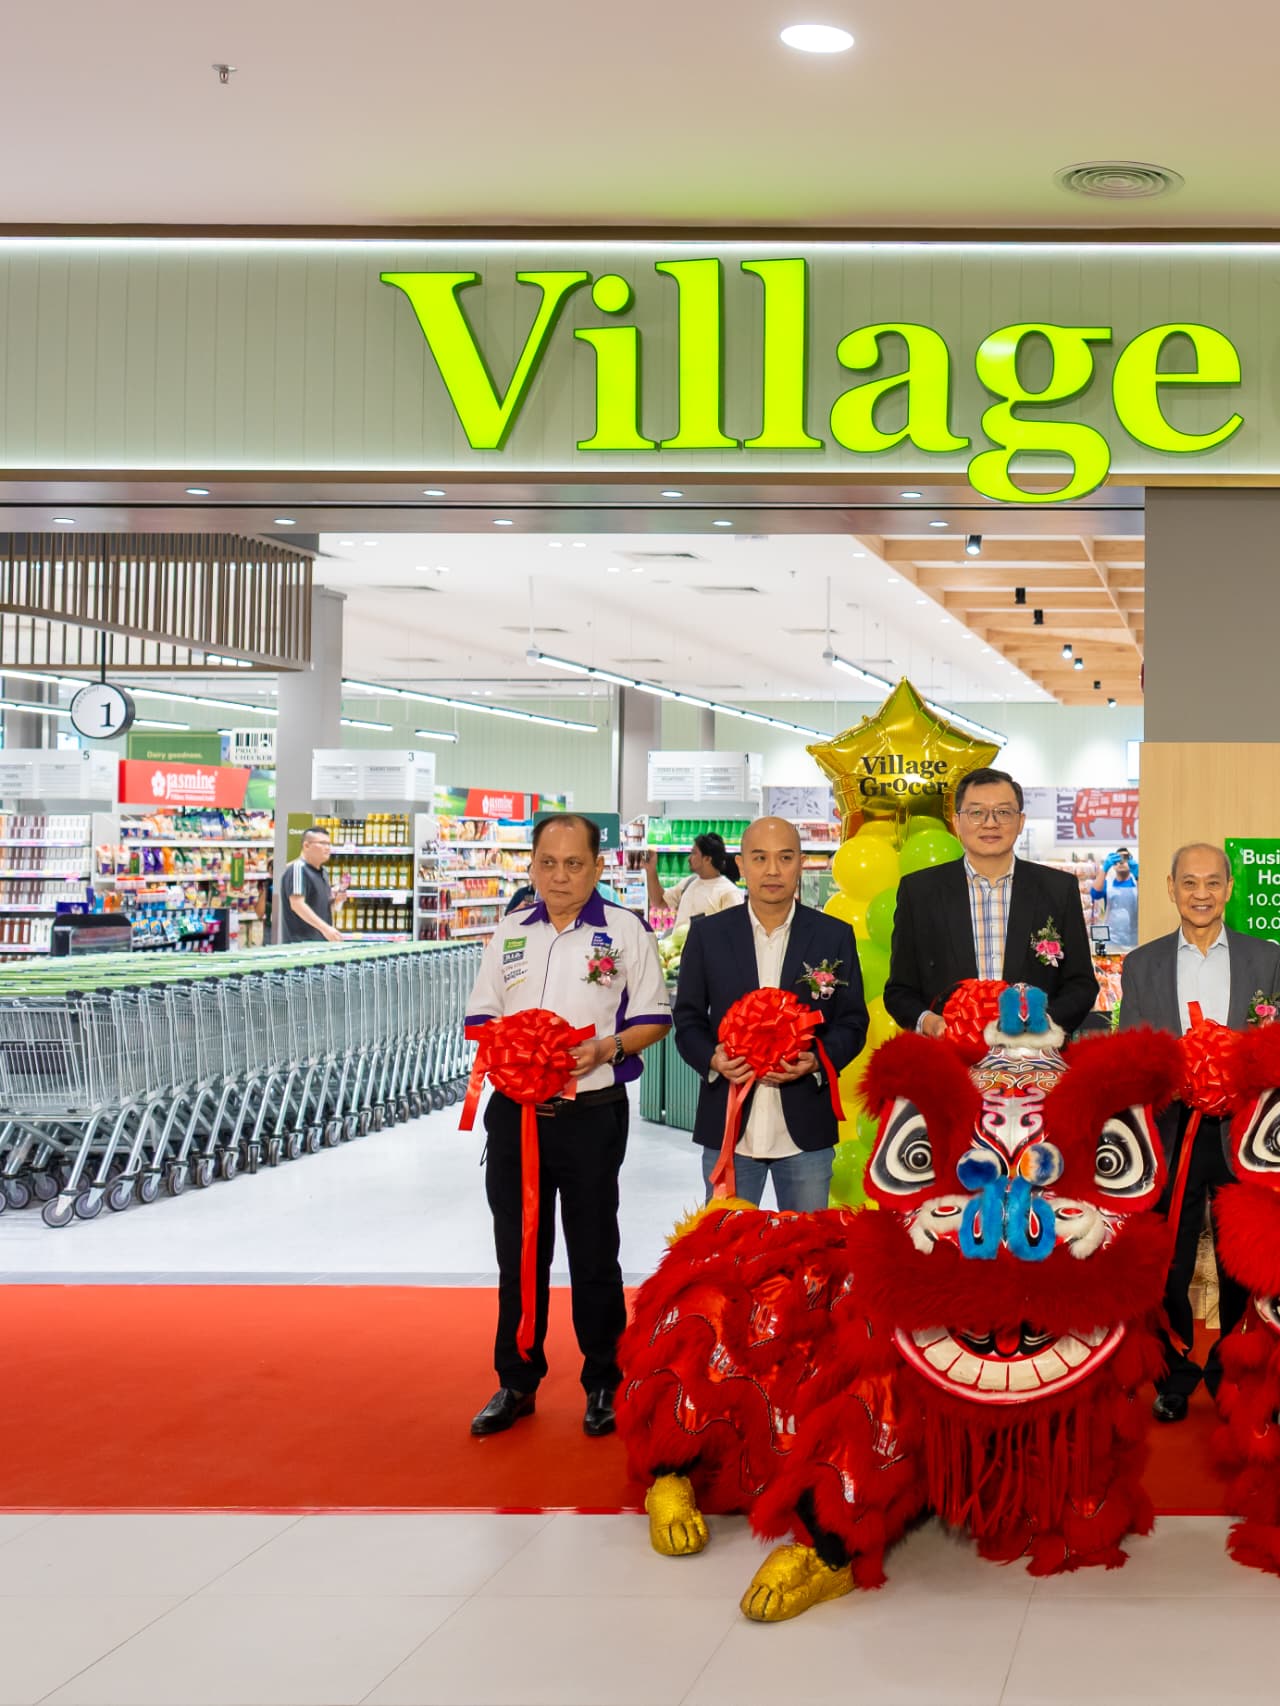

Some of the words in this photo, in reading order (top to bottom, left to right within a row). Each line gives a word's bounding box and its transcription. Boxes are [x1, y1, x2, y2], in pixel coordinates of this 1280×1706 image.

[379, 258, 1245, 503] Village
[100, 701, 115, 728] 1
[83, 750, 90, 760] 5
[408, 751, 415, 762] 3
[860, 754, 948, 779] Village
[859, 776, 948, 797] Grocer
[1056, 793, 1074, 840] MEAT
